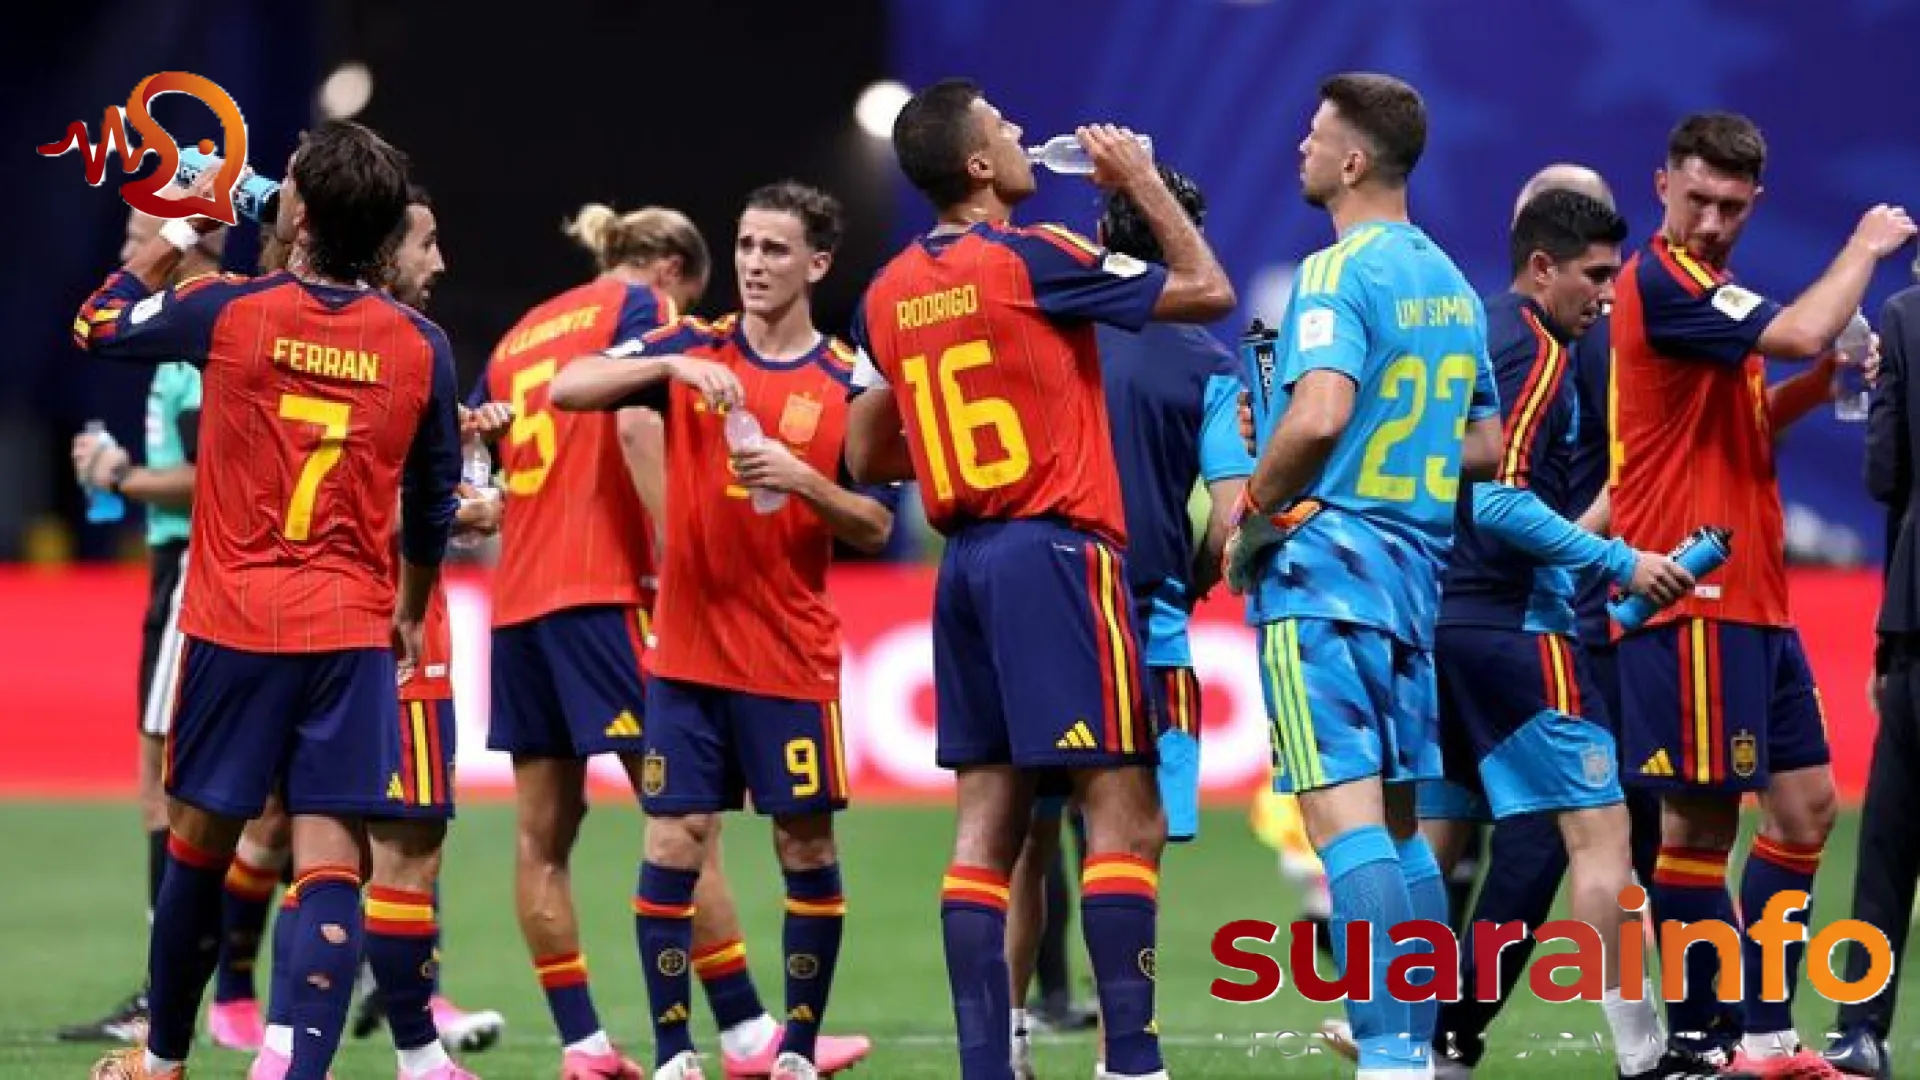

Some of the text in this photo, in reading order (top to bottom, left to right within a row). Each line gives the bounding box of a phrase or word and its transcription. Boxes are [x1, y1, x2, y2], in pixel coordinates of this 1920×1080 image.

[273, 336, 380, 382] FERRAN
[896, 284, 978, 330] RODRIGO
[279, 394, 351, 541] 7
[510, 358, 557, 495] 5
[902, 340, 1031, 501] 16
[1356, 354, 1477, 502] 23
[784, 737, 819, 798] 9
